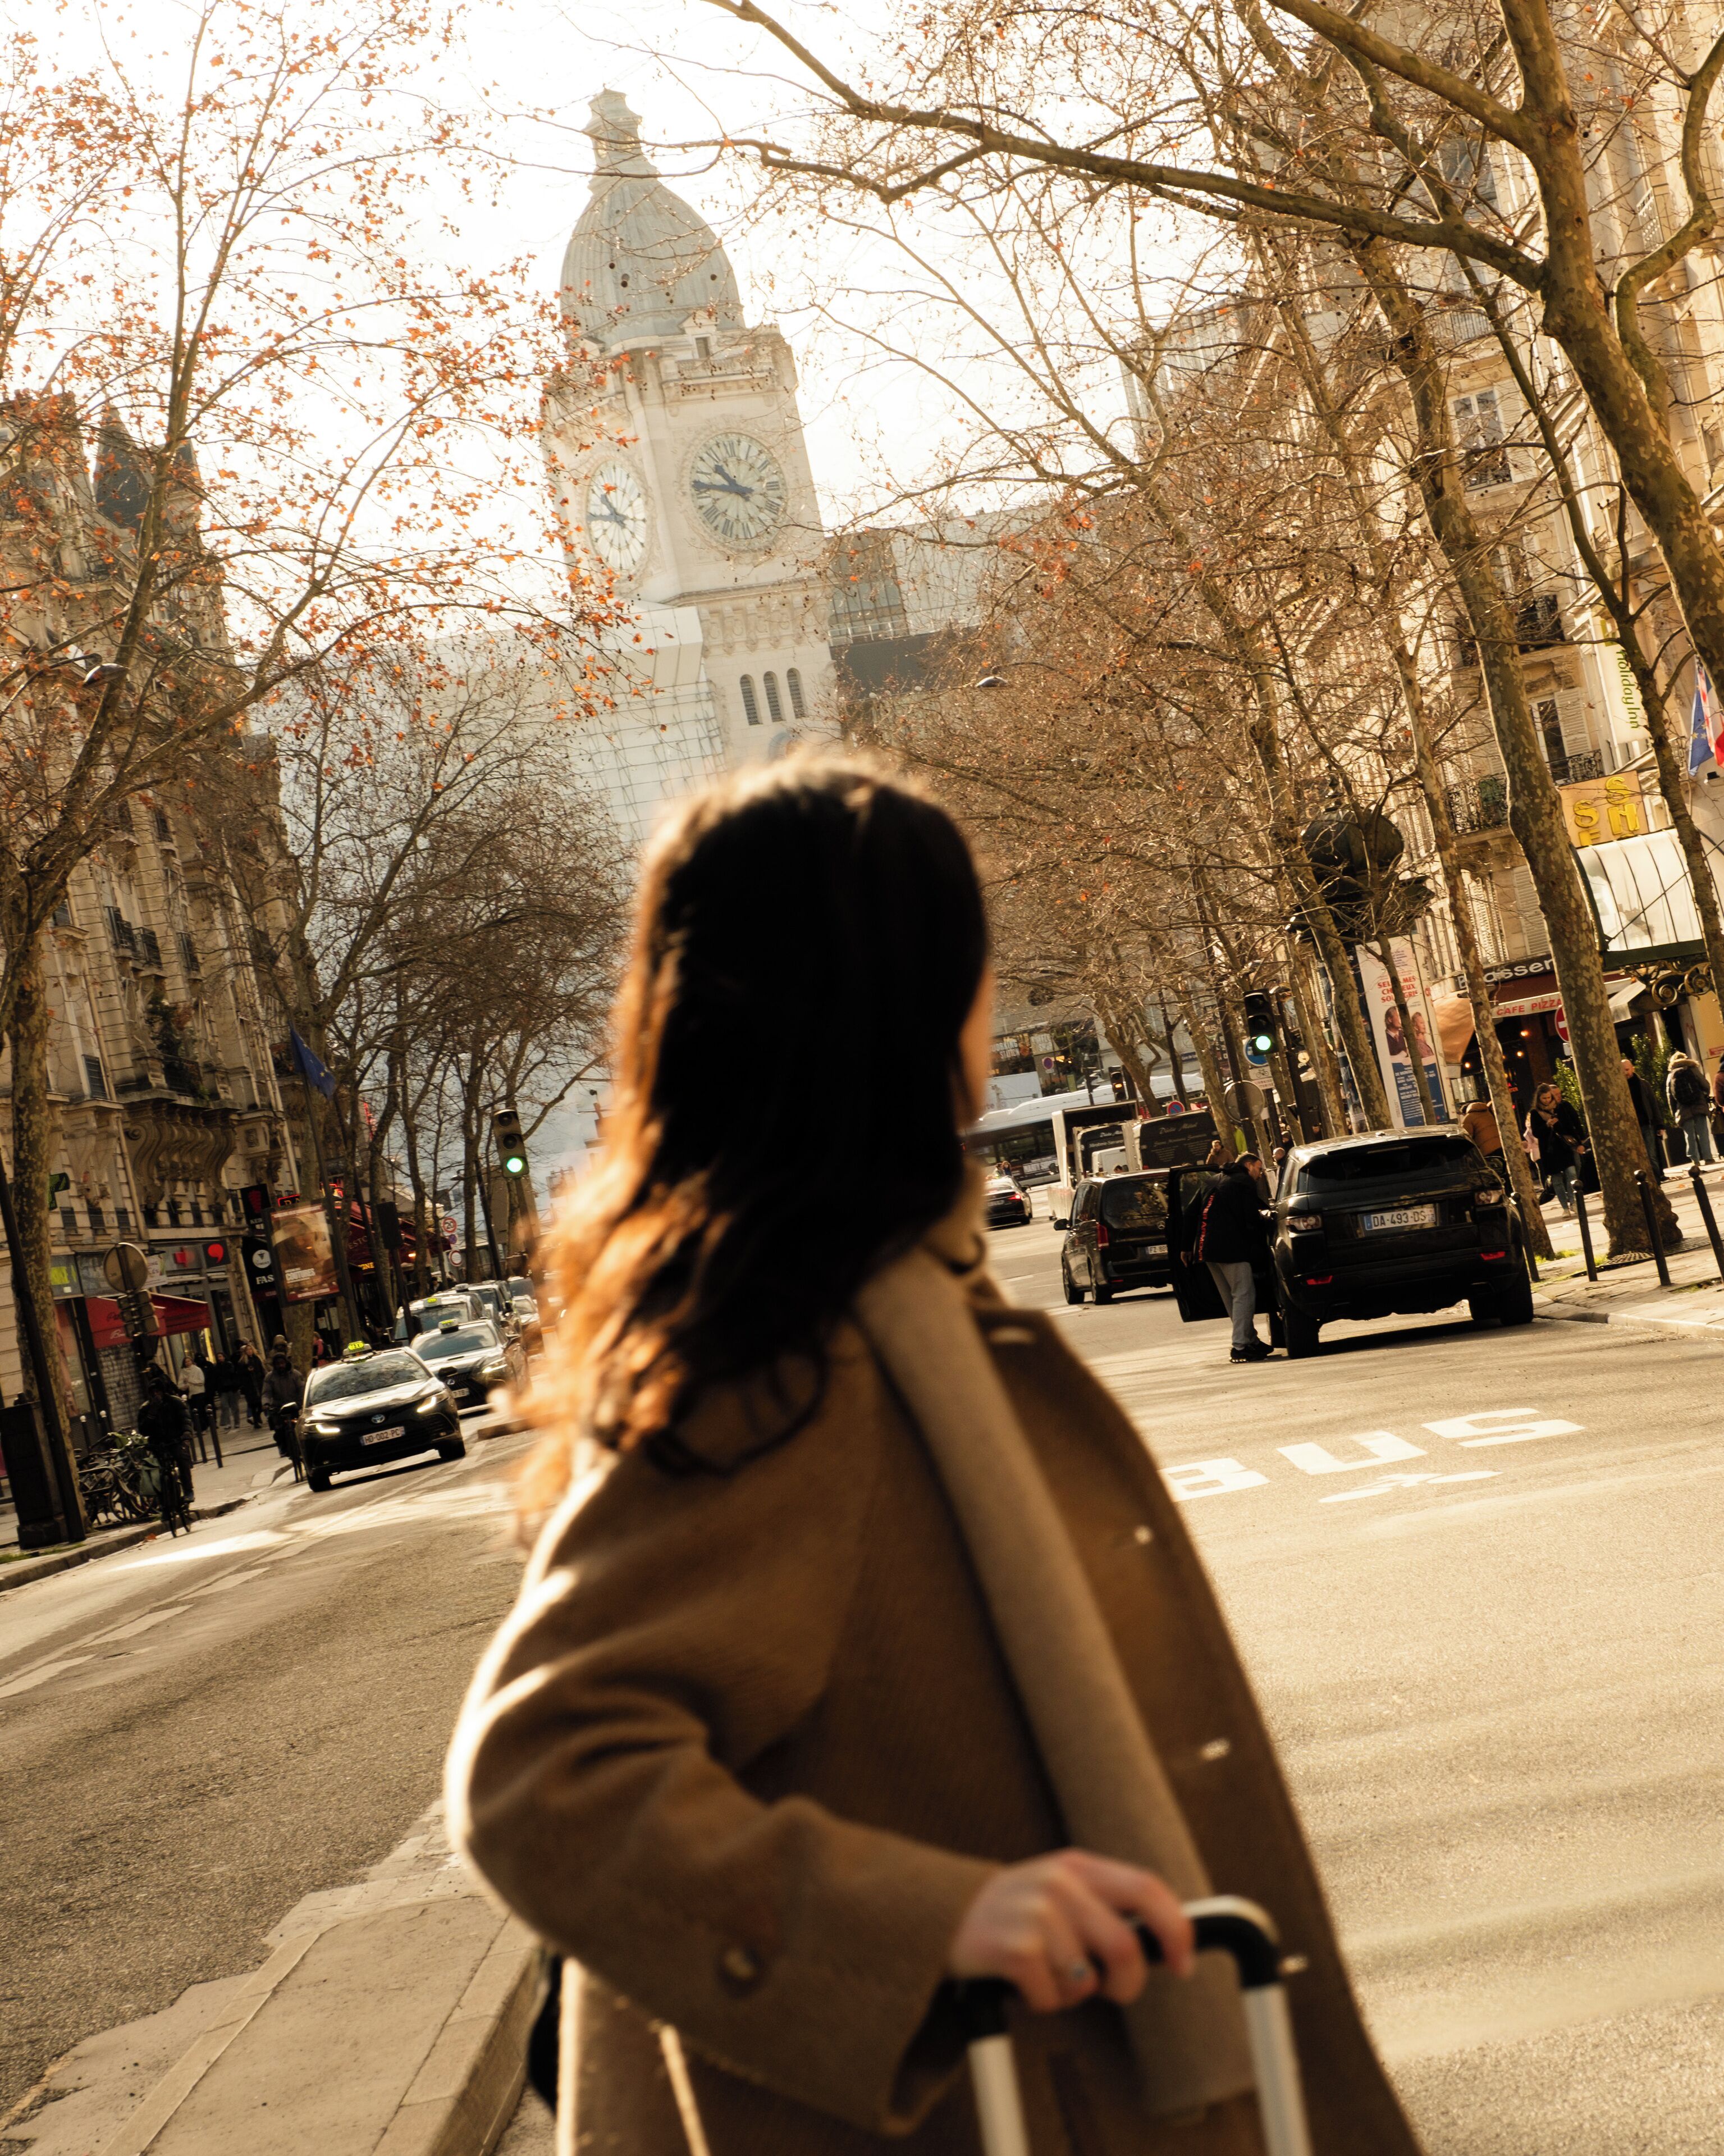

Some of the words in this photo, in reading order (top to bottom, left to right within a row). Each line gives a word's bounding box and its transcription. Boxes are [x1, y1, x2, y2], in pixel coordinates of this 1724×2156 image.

[1616, 650, 1636, 705] Holiday
[1627, 707, 1640, 729] Inn
[1497, 1005, 1525, 1016] CAFE
[444, 1221, 454, 1230] 20
[1373, 1211, 1426, 1227] DA-493-DS
[256, 1275, 275, 1285] FAS
[1159, 1408, 1585, 1502] BUS
